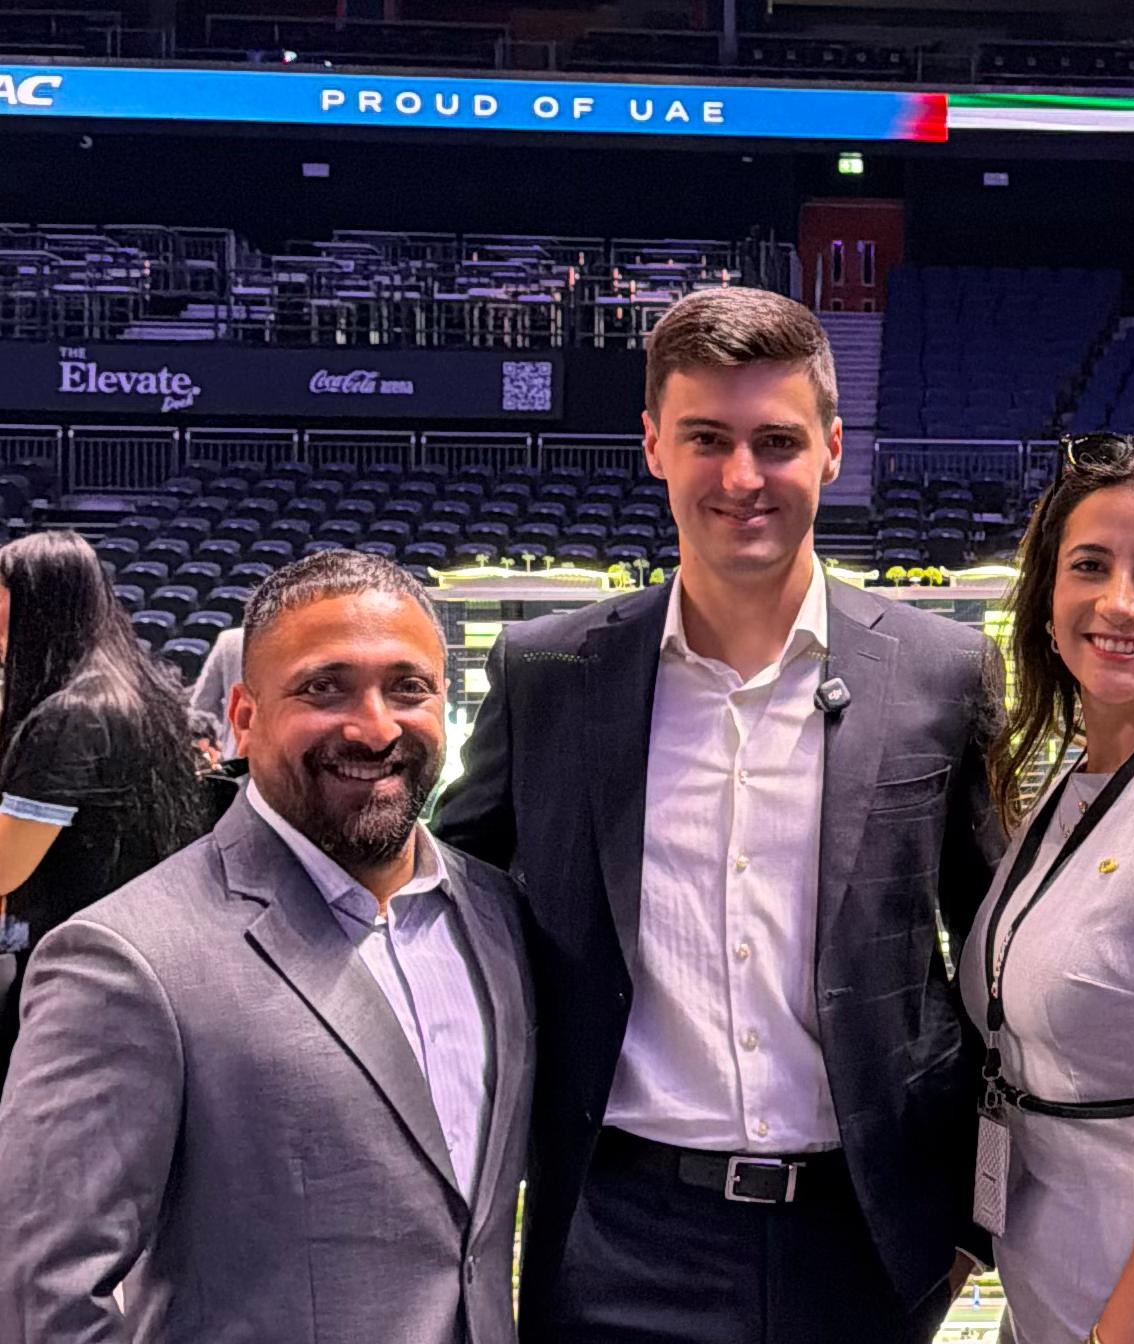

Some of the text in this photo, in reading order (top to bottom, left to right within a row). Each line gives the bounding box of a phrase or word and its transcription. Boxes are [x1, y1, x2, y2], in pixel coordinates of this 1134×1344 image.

[322, 89, 723, 123] PROUD OF UAE
[59, 346, 87, 359] THE
